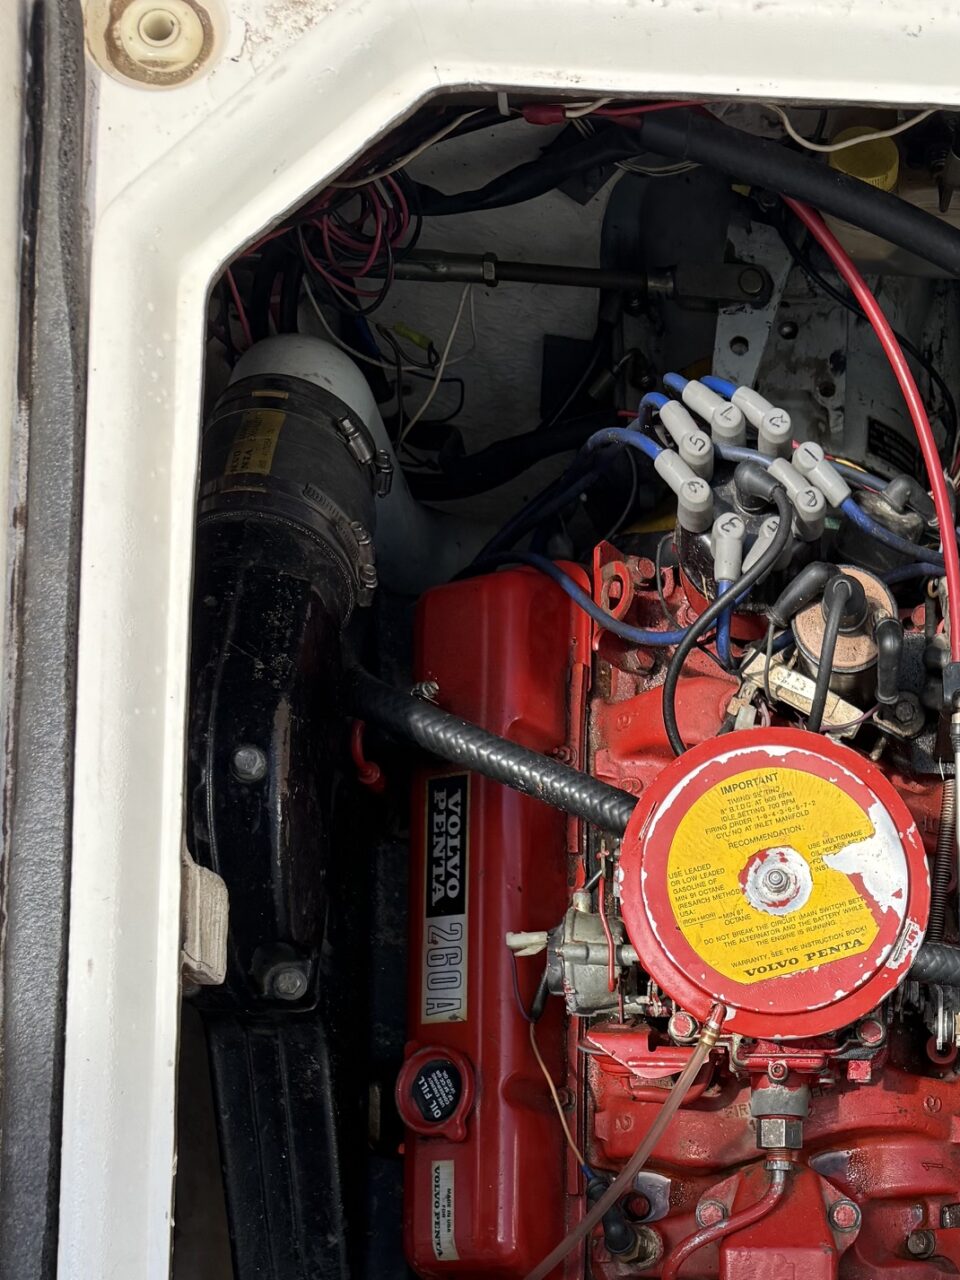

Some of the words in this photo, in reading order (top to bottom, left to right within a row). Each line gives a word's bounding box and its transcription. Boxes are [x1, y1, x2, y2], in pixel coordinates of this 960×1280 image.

[689, 435, 706, 452] 5
[720, 516, 742, 533] 3
[720, 771, 779, 795] IMPORTANT
[720, 813, 736, 823] IDLE
[737, 805, 765, 818] SETTING
[767, 801, 779, 809] 700
[780, 797, 795, 806] RPM
[753, 819, 772, 829] INLET
[775, 808, 809, 823] MANIFOLD
[704, 824, 727, 835] FIRING
[729, 816, 752, 828] ORDER
[431, 789, 446, 906] PENTA
[445, 788, 461, 898] VOLVO
[807, 841, 820, 849] USE
[668, 870, 682, 879] USE
[684, 862, 711, 875] LEADED
[682, 874, 698, 883] LOW
[699, 867, 725, 879] LEADED
[672, 881, 706, 894] GASOLINE
[707, 877, 717, 885] OF
[675, 894, 687, 902] MIN
[697, 883, 724, 896] OCTANE
[724, 913, 751, 926] OCTANE
[724, 939, 737, 947] THE
[738, 927, 779, 944] ALTERNATOR
[782, 923, 796, 931] AND
[797, 918, 811, 927] THE
[812, 909, 841, 922] BATTERY
[842, 903, 863, 914] WHILE
[703, 937, 714, 945] DO
[715, 933, 730, 942] NOT
[731, 926, 753, 938] BREAK
[755, 923, 768, 931] THE
[770, 915, 796, 927] CIRCUIT
[755, 938, 768, 946] THE
[770, 931, 795, 942] ENGINE
[770, 949, 783, 957] SEE
[785, 944, 799, 953] THE
[800, 932, 844, 949] INSTRUCTION
[743, 956, 800, 978] VOLVO
[804, 937, 865, 961] PENTA
[416, 1075, 433, 1099] FILL
[428, 1099, 442, 1118] OIL
